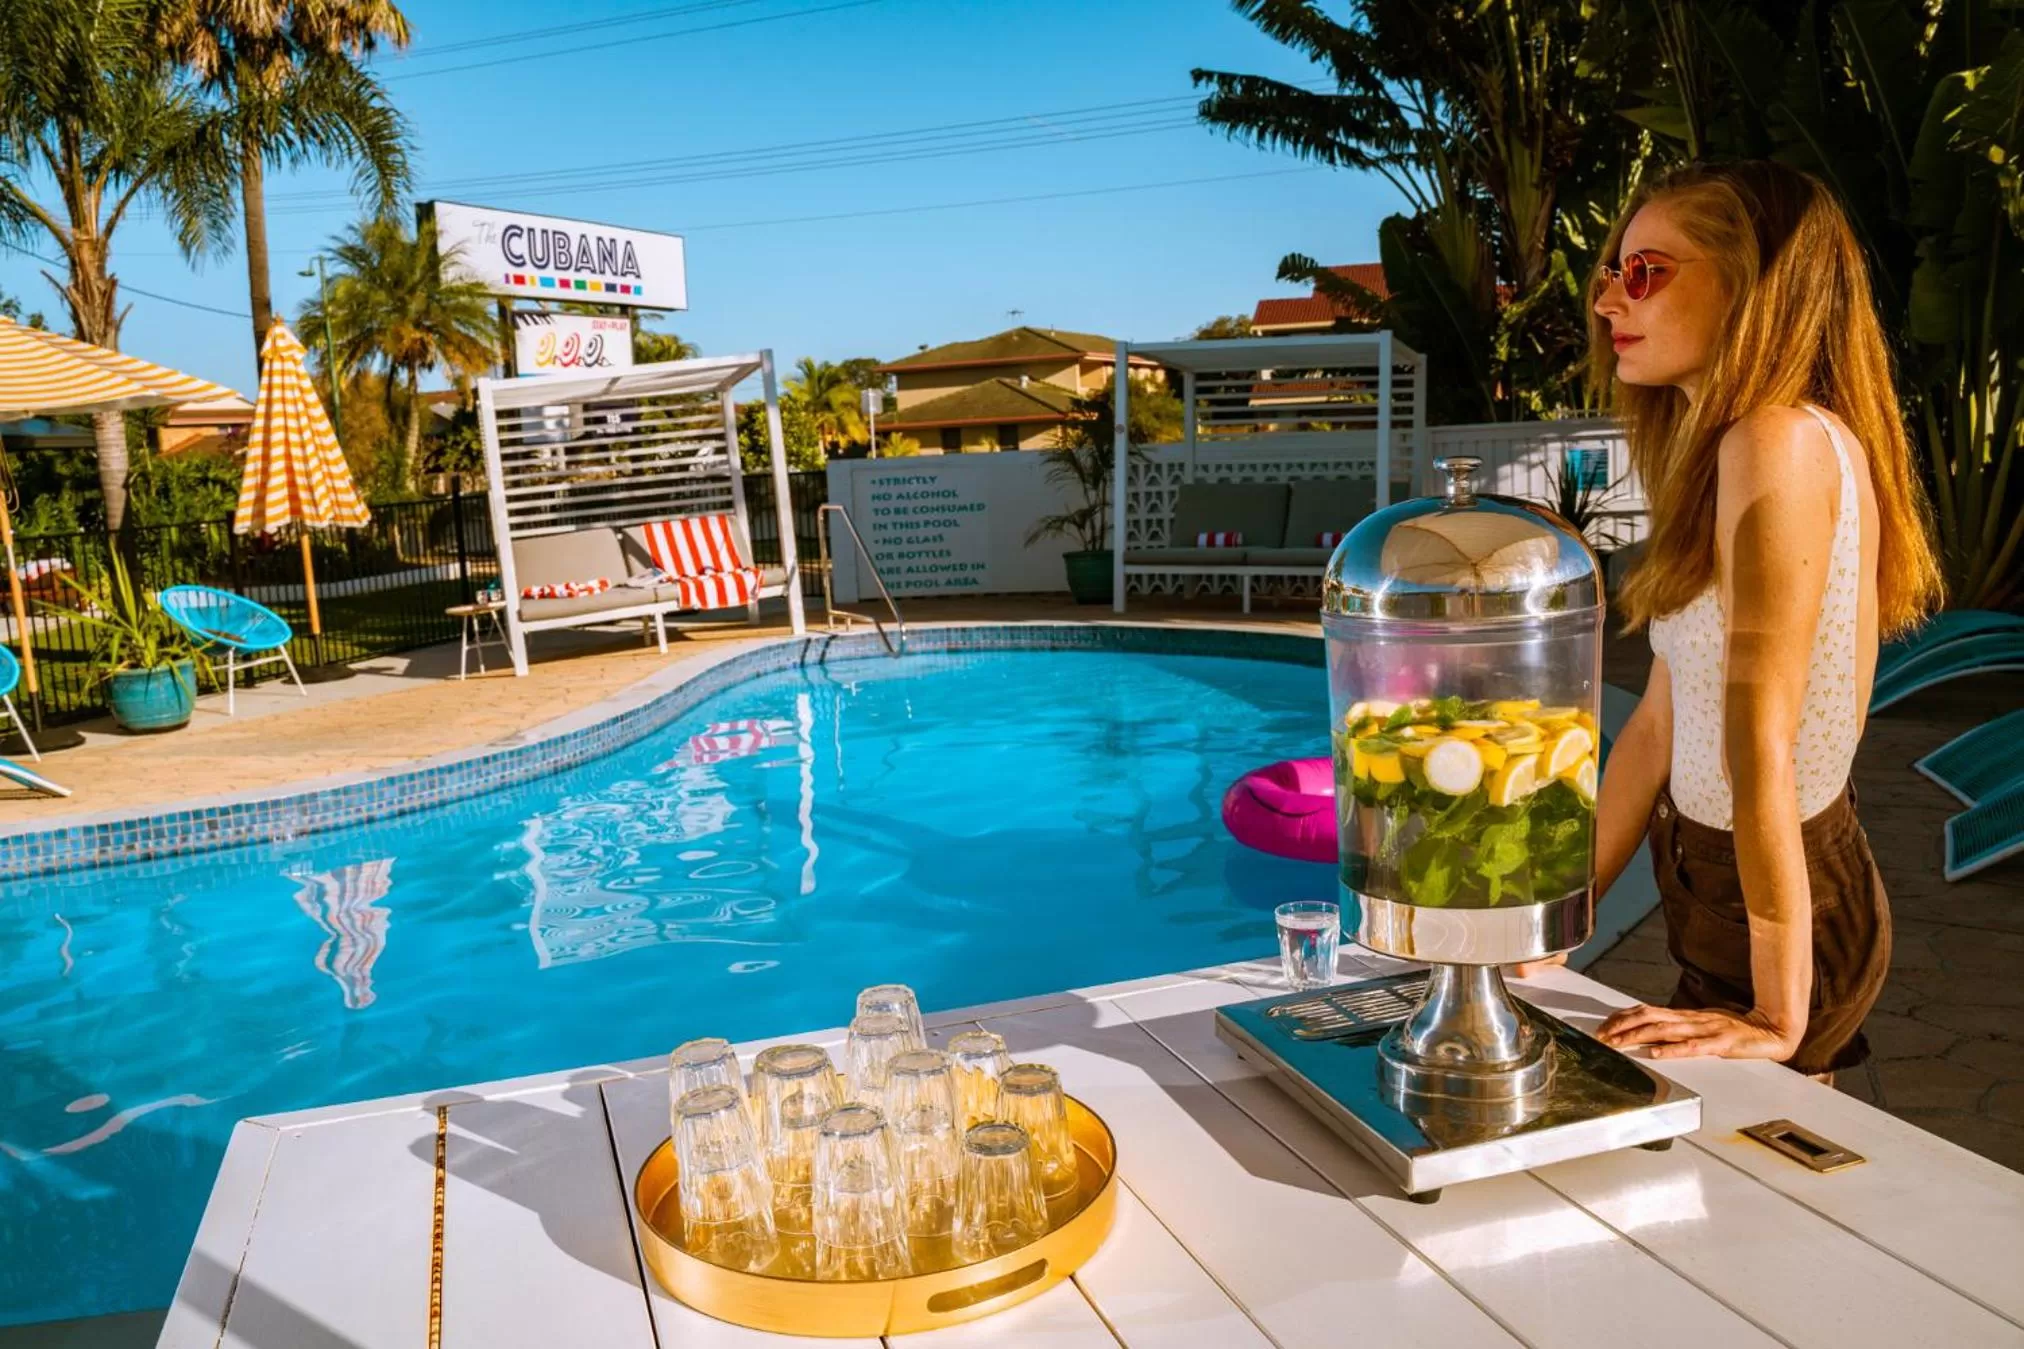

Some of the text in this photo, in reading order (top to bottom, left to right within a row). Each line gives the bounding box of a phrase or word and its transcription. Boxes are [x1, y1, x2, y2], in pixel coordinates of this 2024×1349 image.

[471, 219, 642, 279] The CUBANA
[878, 476, 938, 486] STRICTLY
[871, 489, 959, 501] NO ALCOHOL
[873, 503, 986, 516] TO BE CONSUMED
[872, 519, 960, 531] IN THIS POOL
[882, 534, 945, 545] NO GLASS
[875, 550, 952, 561] OR BOTTLES
[878, 562, 986, 575] ARE ALLOWED IN
[885, 577, 979, 590] HE POOL AREA
